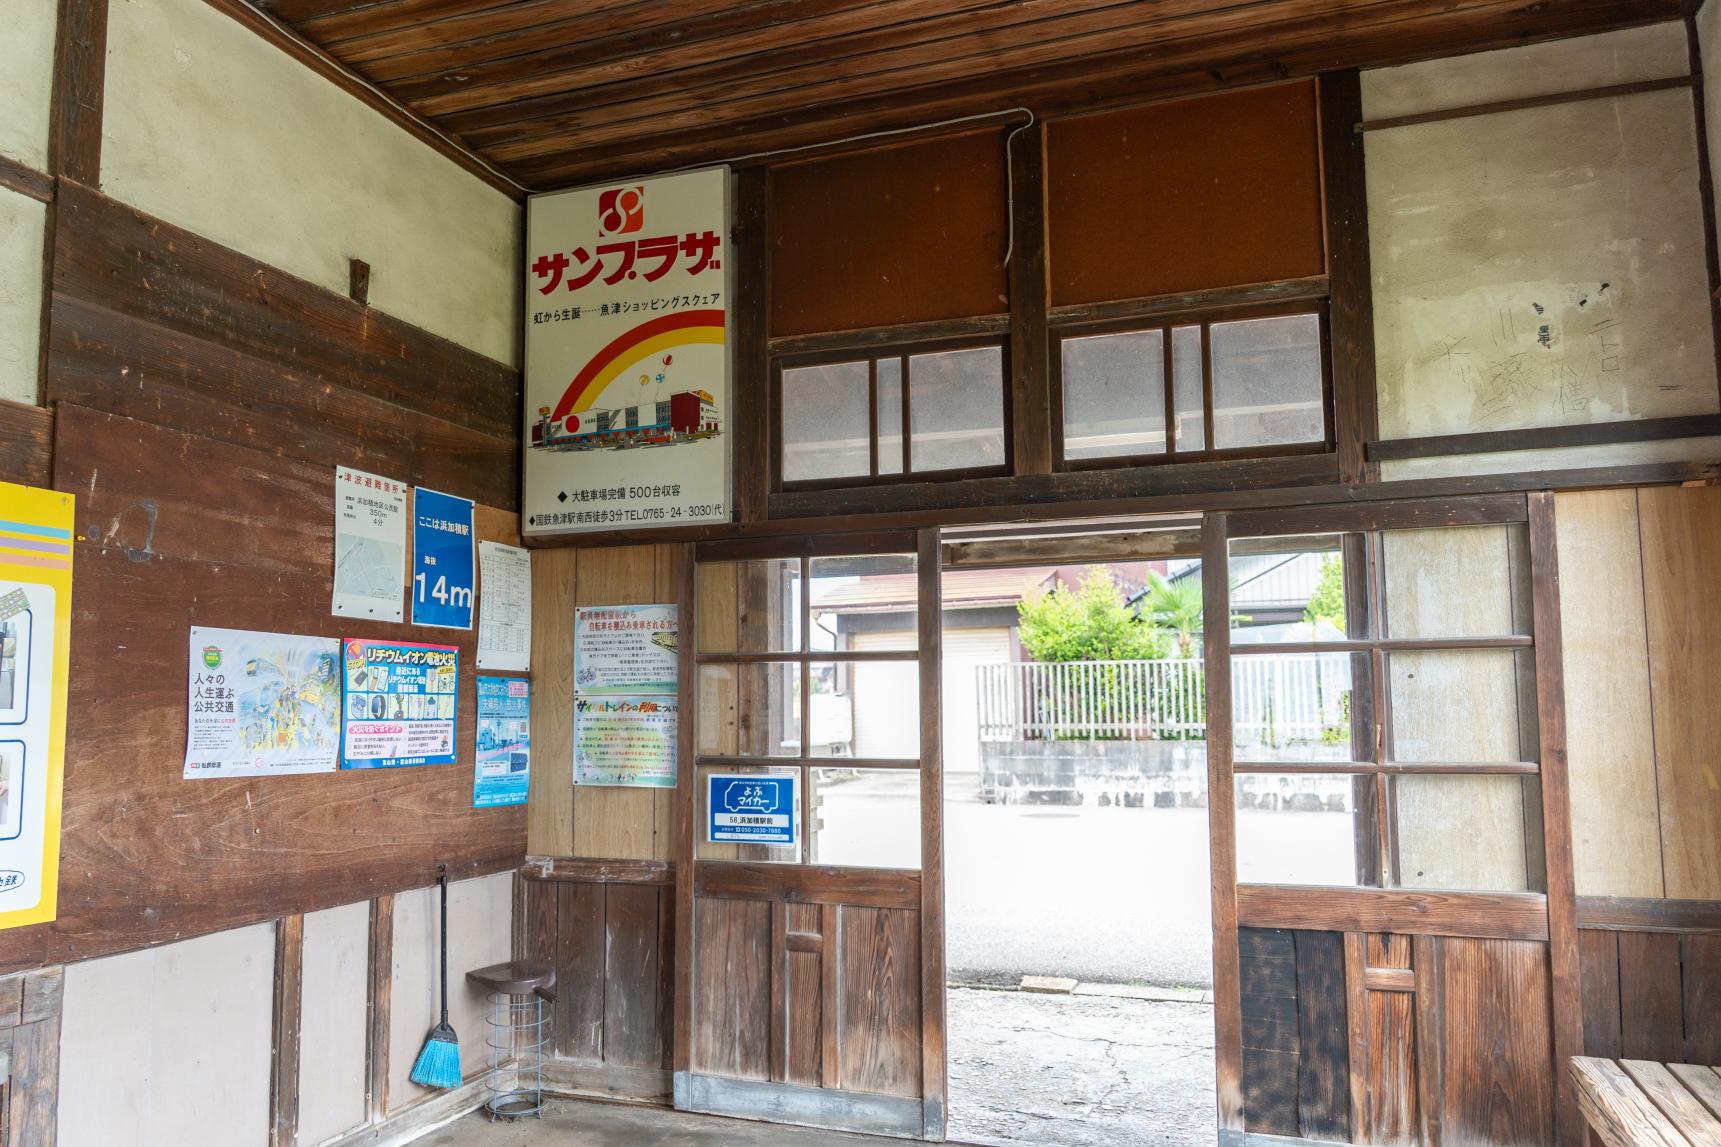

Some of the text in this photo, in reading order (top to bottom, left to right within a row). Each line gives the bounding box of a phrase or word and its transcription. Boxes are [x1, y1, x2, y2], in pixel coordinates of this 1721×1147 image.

[532, 230, 721, 296] サンプラザ
[571, 484, 681, 503] 大駐車場完備 500台収容
[369, 508, 388, 520] 350m
[372, 517, 384, 528] 4分
[418, 515, 470, 537] ここは浜加積駅
[424, 555, 437, 566] 海抜
[415, 571, 472, 609] 14m
[367, 647, 456, 667] リチウムイオン電池火災
[193, 672, 225, 685] 人々の
[193, 687, 236, 700] 人生運ぶ
[193, 701, 235, 714] 公共交通
[743, 786, 763, 797] よぶ
[737, 796, 770, 806] マイカー
